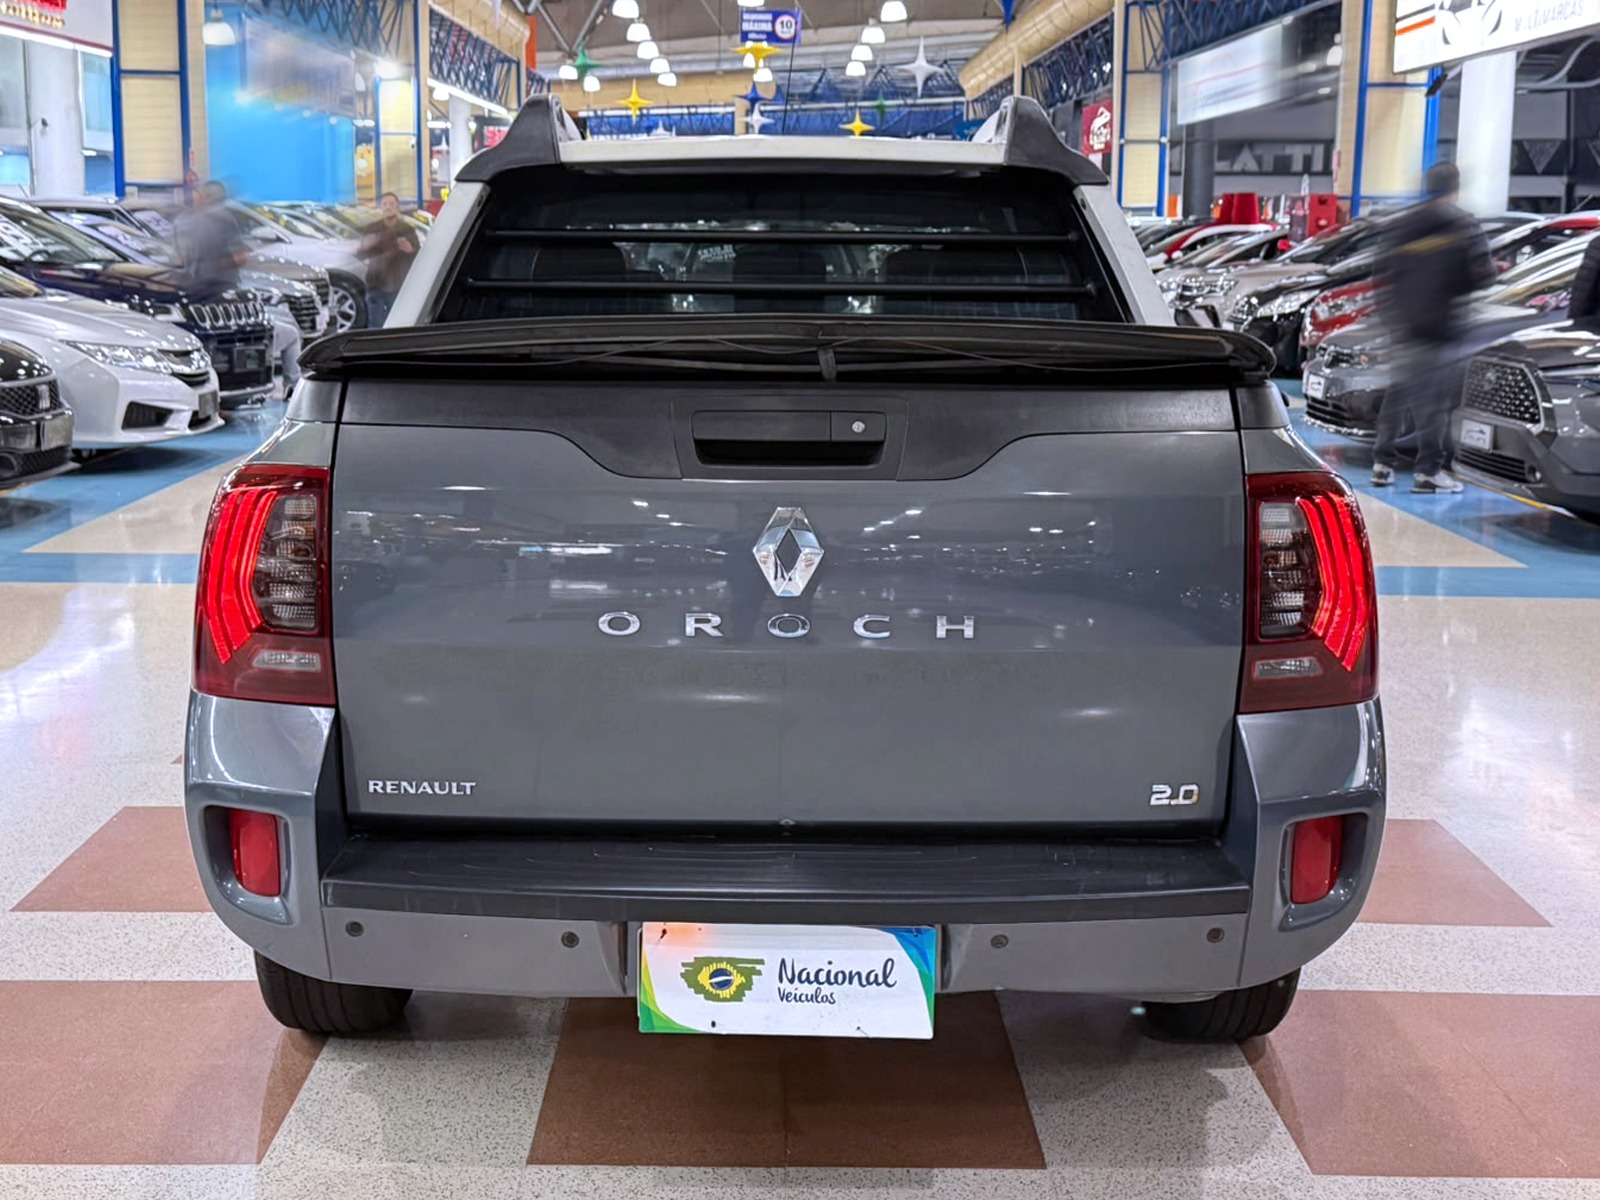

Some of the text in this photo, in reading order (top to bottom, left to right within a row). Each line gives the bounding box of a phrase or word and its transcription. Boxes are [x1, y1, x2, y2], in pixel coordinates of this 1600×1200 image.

[780, 19, 793, 30] 10
[1514, 0, 1584, 33] MLTIMARCAS
[598, 611, 975, 639] OROCH
[368, 780, 476, 795] RENAULT
[1150, 784, 1199, 805] 2.0
[778, 958, 897, 988] Nacional
